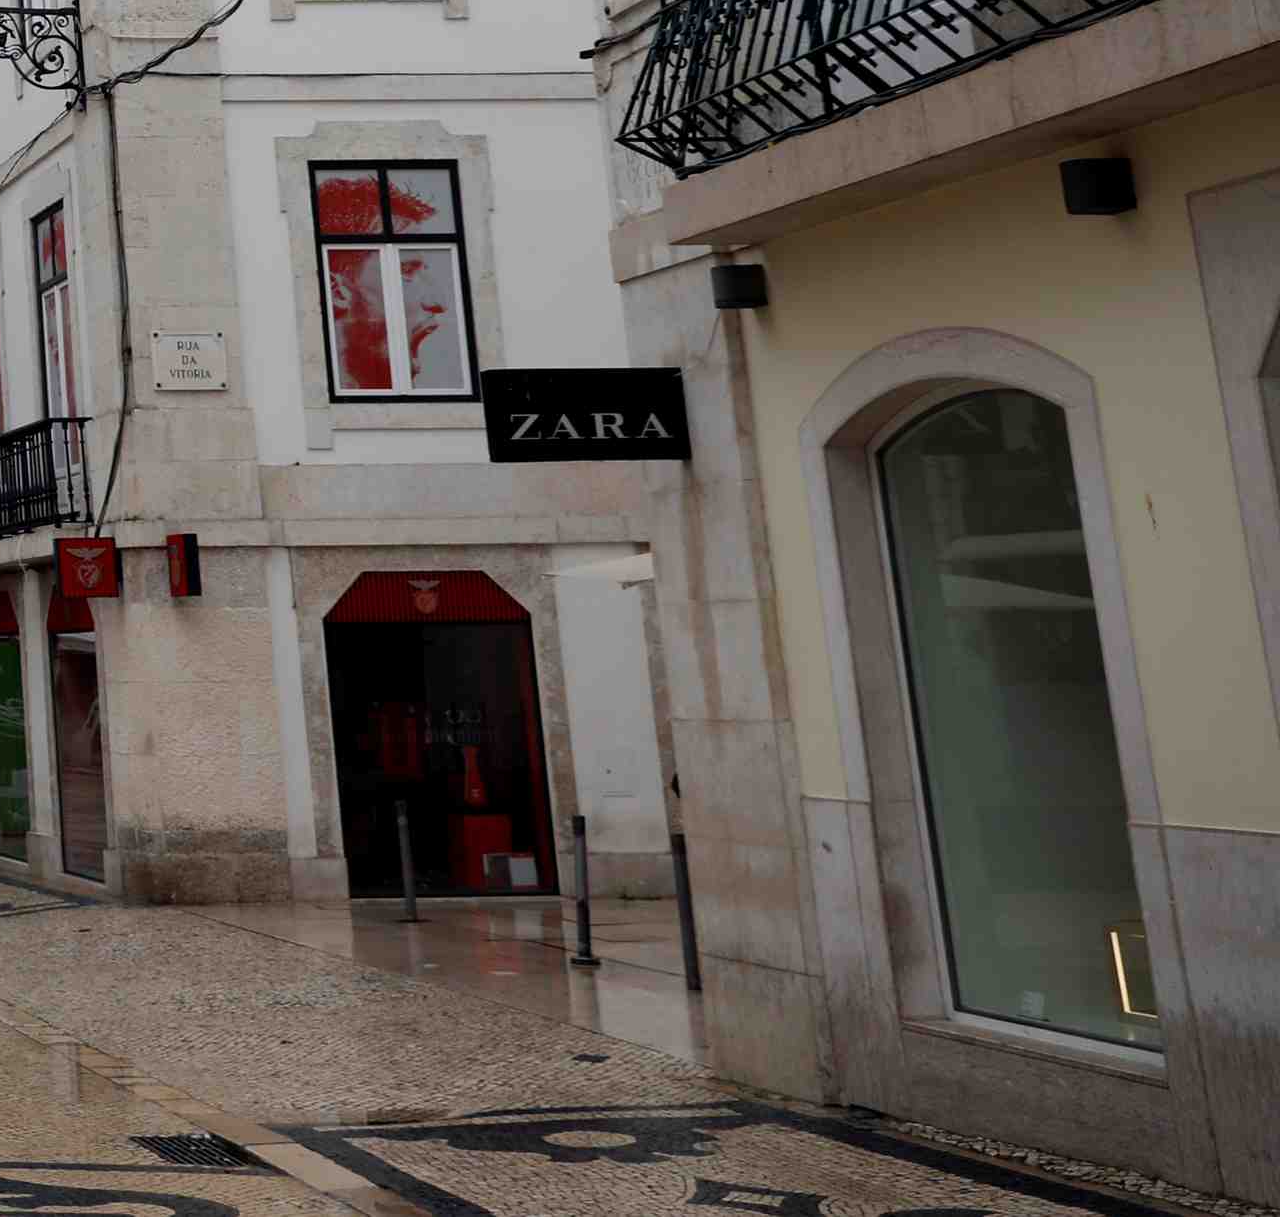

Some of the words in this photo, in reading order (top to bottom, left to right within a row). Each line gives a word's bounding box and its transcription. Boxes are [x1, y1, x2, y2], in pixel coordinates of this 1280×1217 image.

[177, 341, 200, 351] RUA
[182, 355, 197, 365] DA
[509, 412, 676, 441] ZARA
